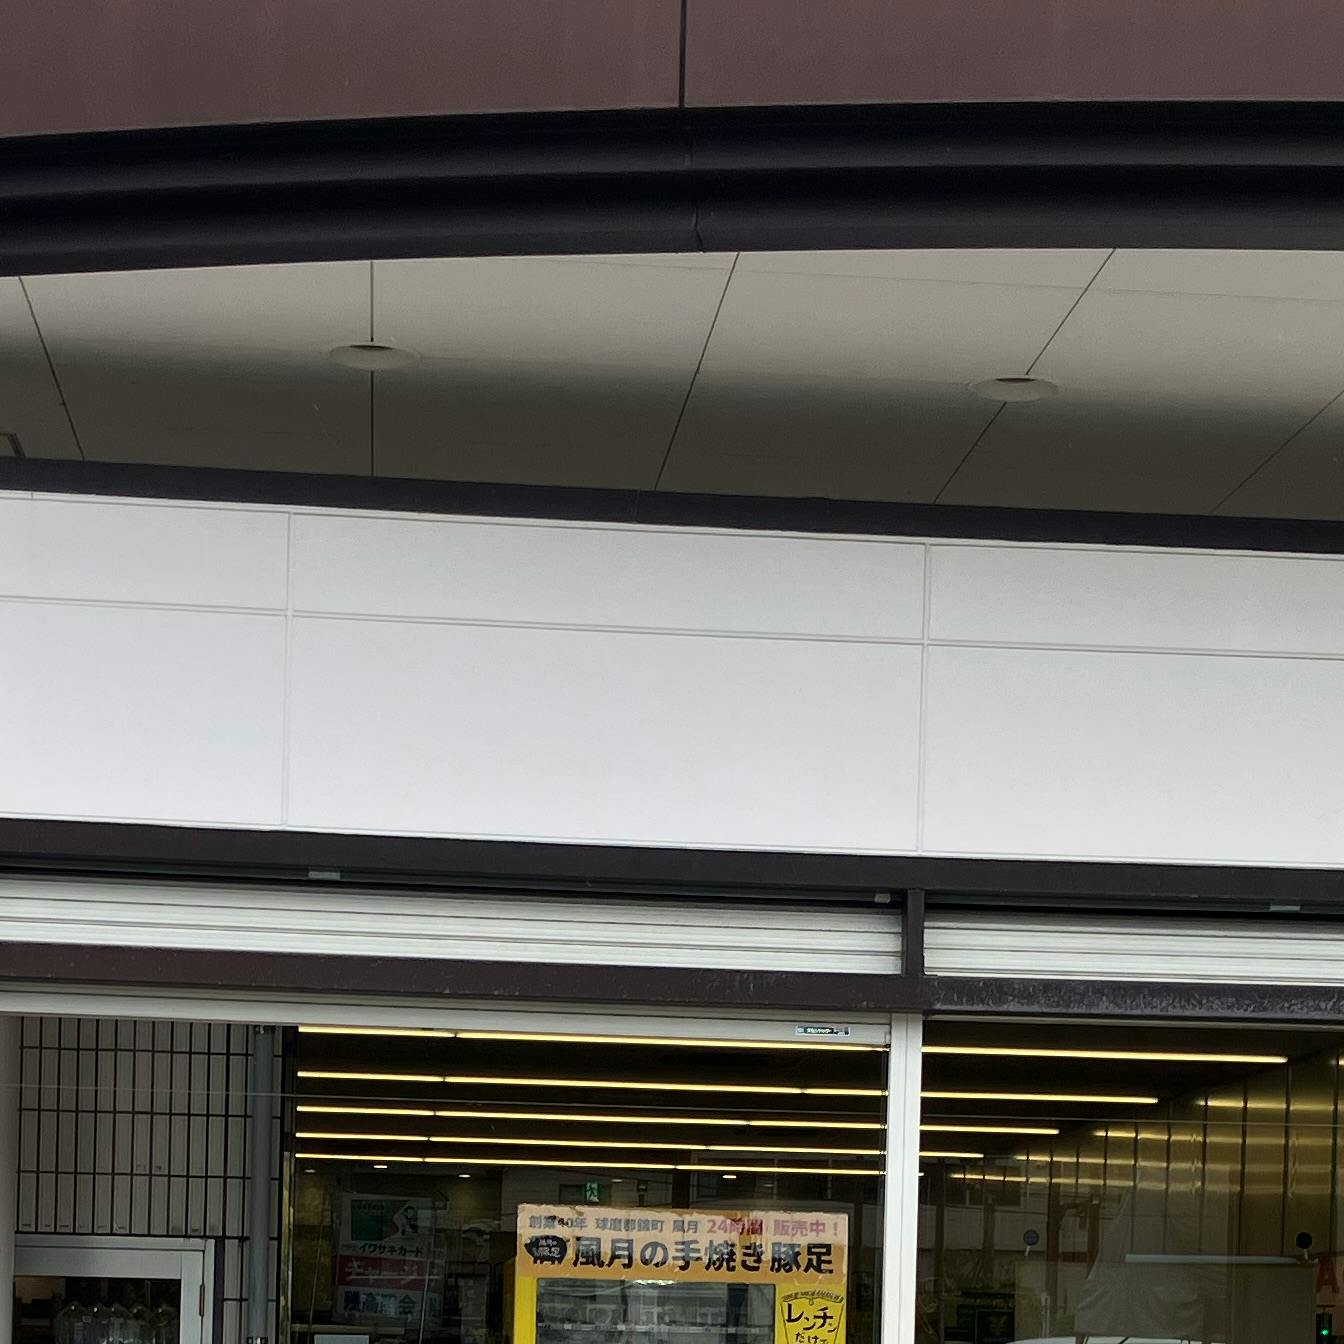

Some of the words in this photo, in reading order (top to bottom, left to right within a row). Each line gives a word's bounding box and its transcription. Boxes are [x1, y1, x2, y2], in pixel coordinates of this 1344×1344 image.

[359, 1243, 423, 1257] イワサキカード
[572, 1236, 834, 1275] 風月の手焼き豚足
